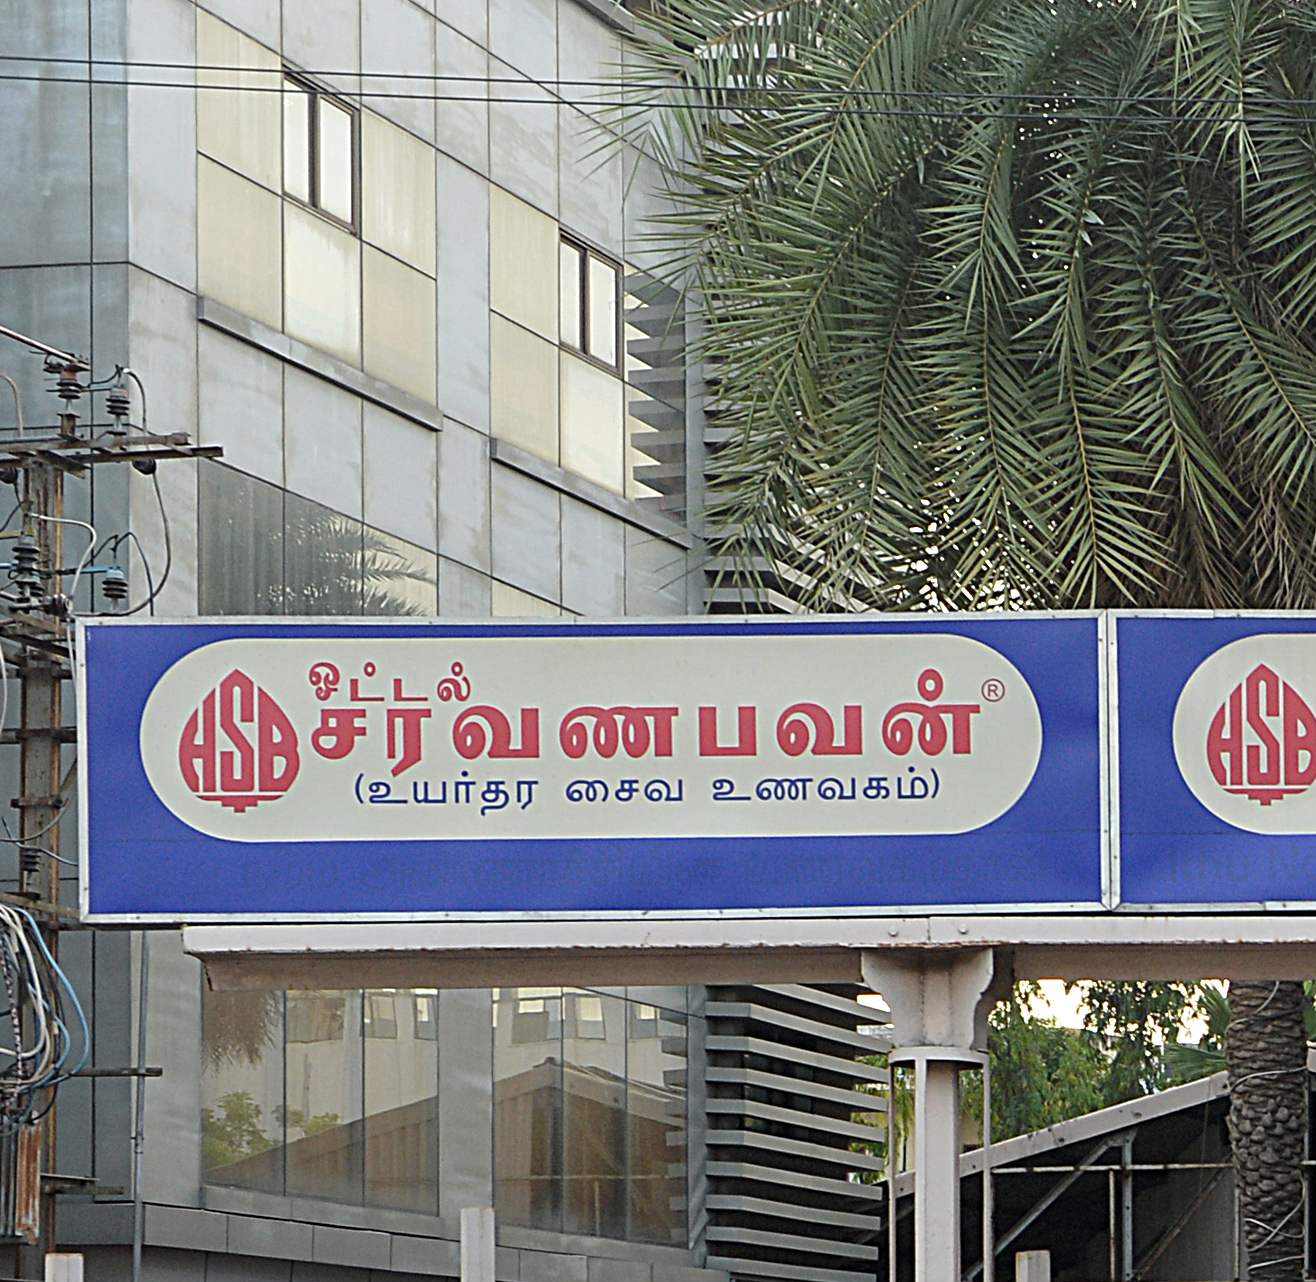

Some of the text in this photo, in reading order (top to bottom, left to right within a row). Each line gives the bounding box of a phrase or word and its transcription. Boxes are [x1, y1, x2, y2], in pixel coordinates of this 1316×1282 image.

[309, 662, 471, 702] ஓட்டல்
[311, 668, 981, 777] சரவணபவன்
[354, 766, 940, 817] (உயர்தர சைவ உணவகம்)
